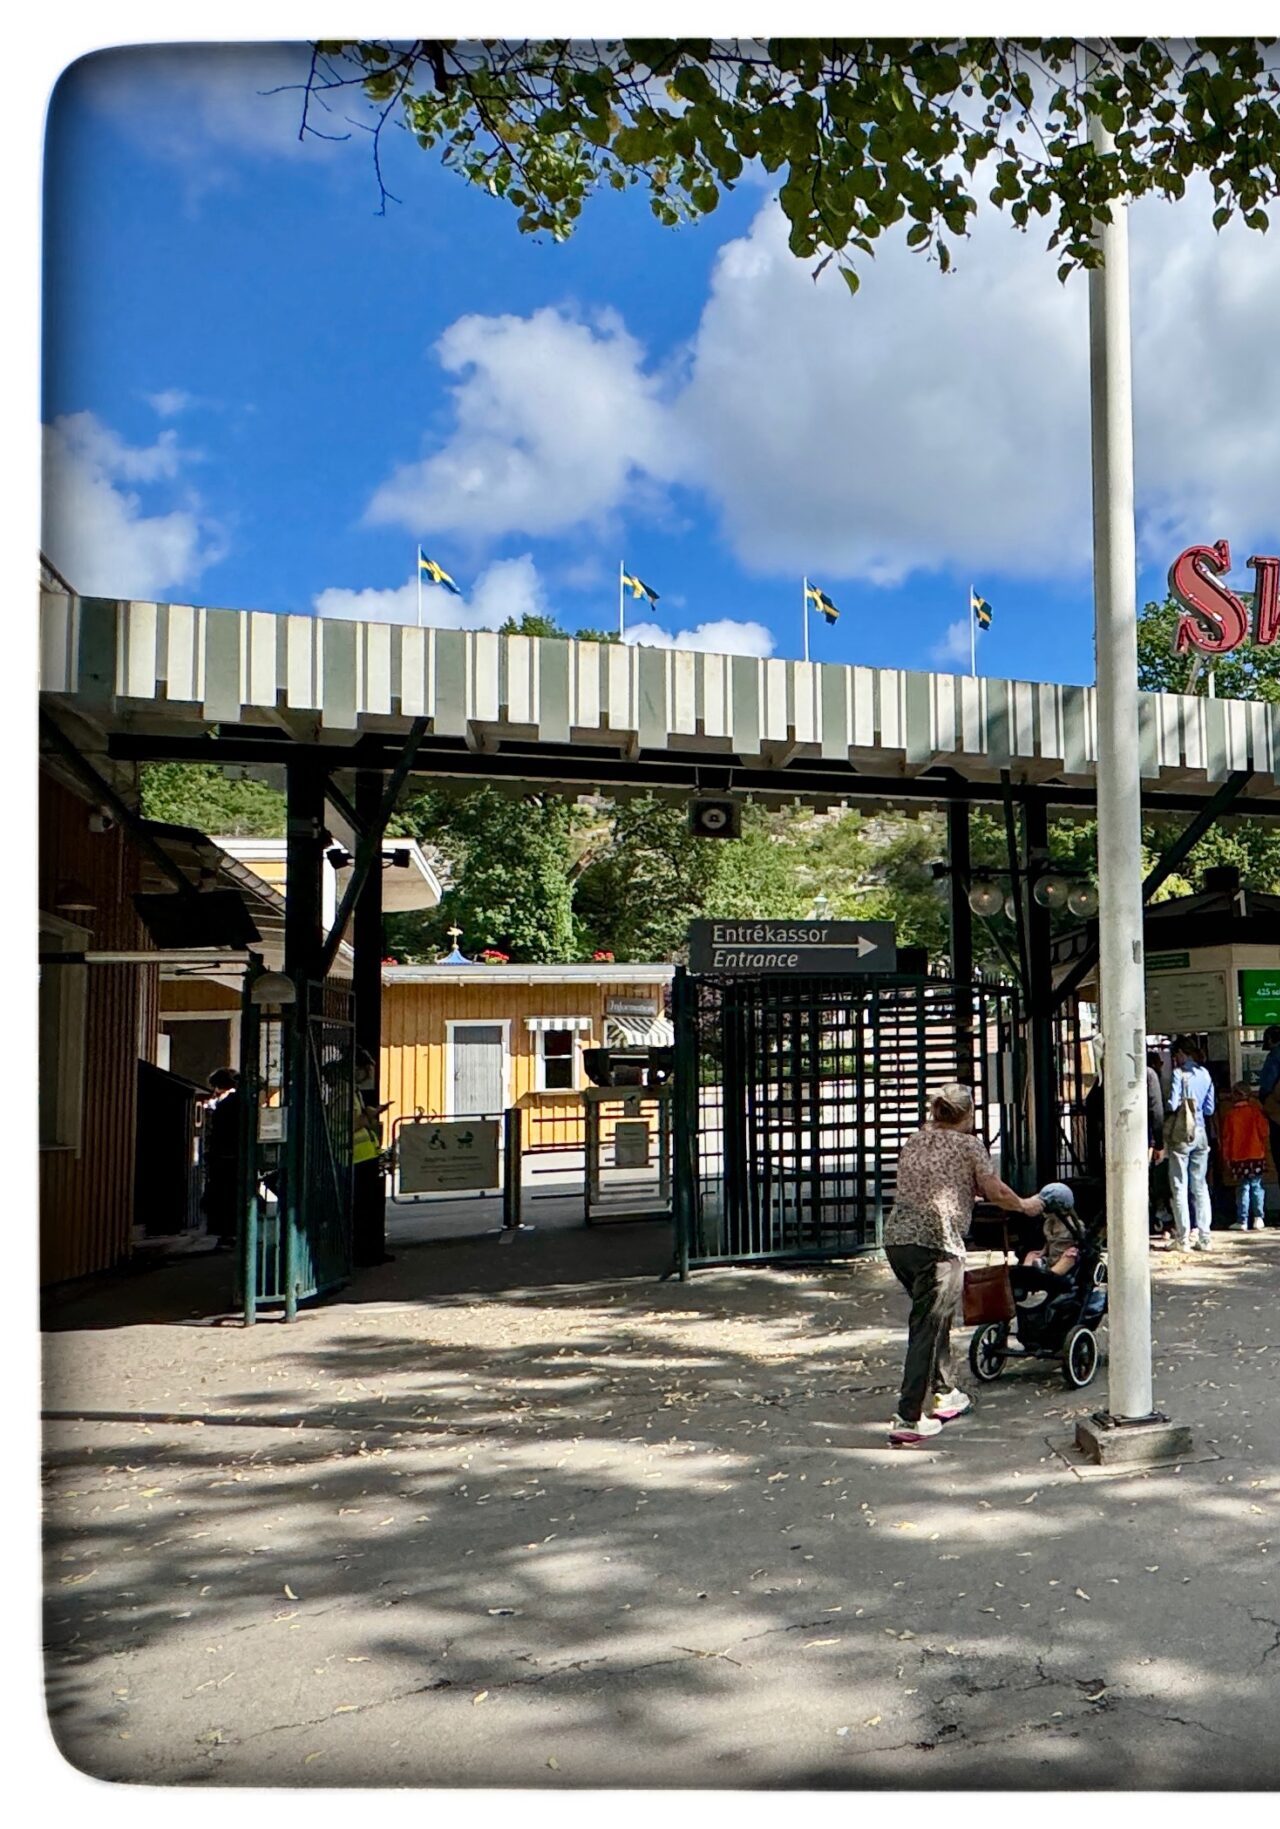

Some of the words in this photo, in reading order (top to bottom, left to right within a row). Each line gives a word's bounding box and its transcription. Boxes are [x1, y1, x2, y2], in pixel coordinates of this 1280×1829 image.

[1233, 890, 1248, 917] 1
[713, 924, 829, 943] Entrékassor
[713, 950, 799, 968] Entrance
